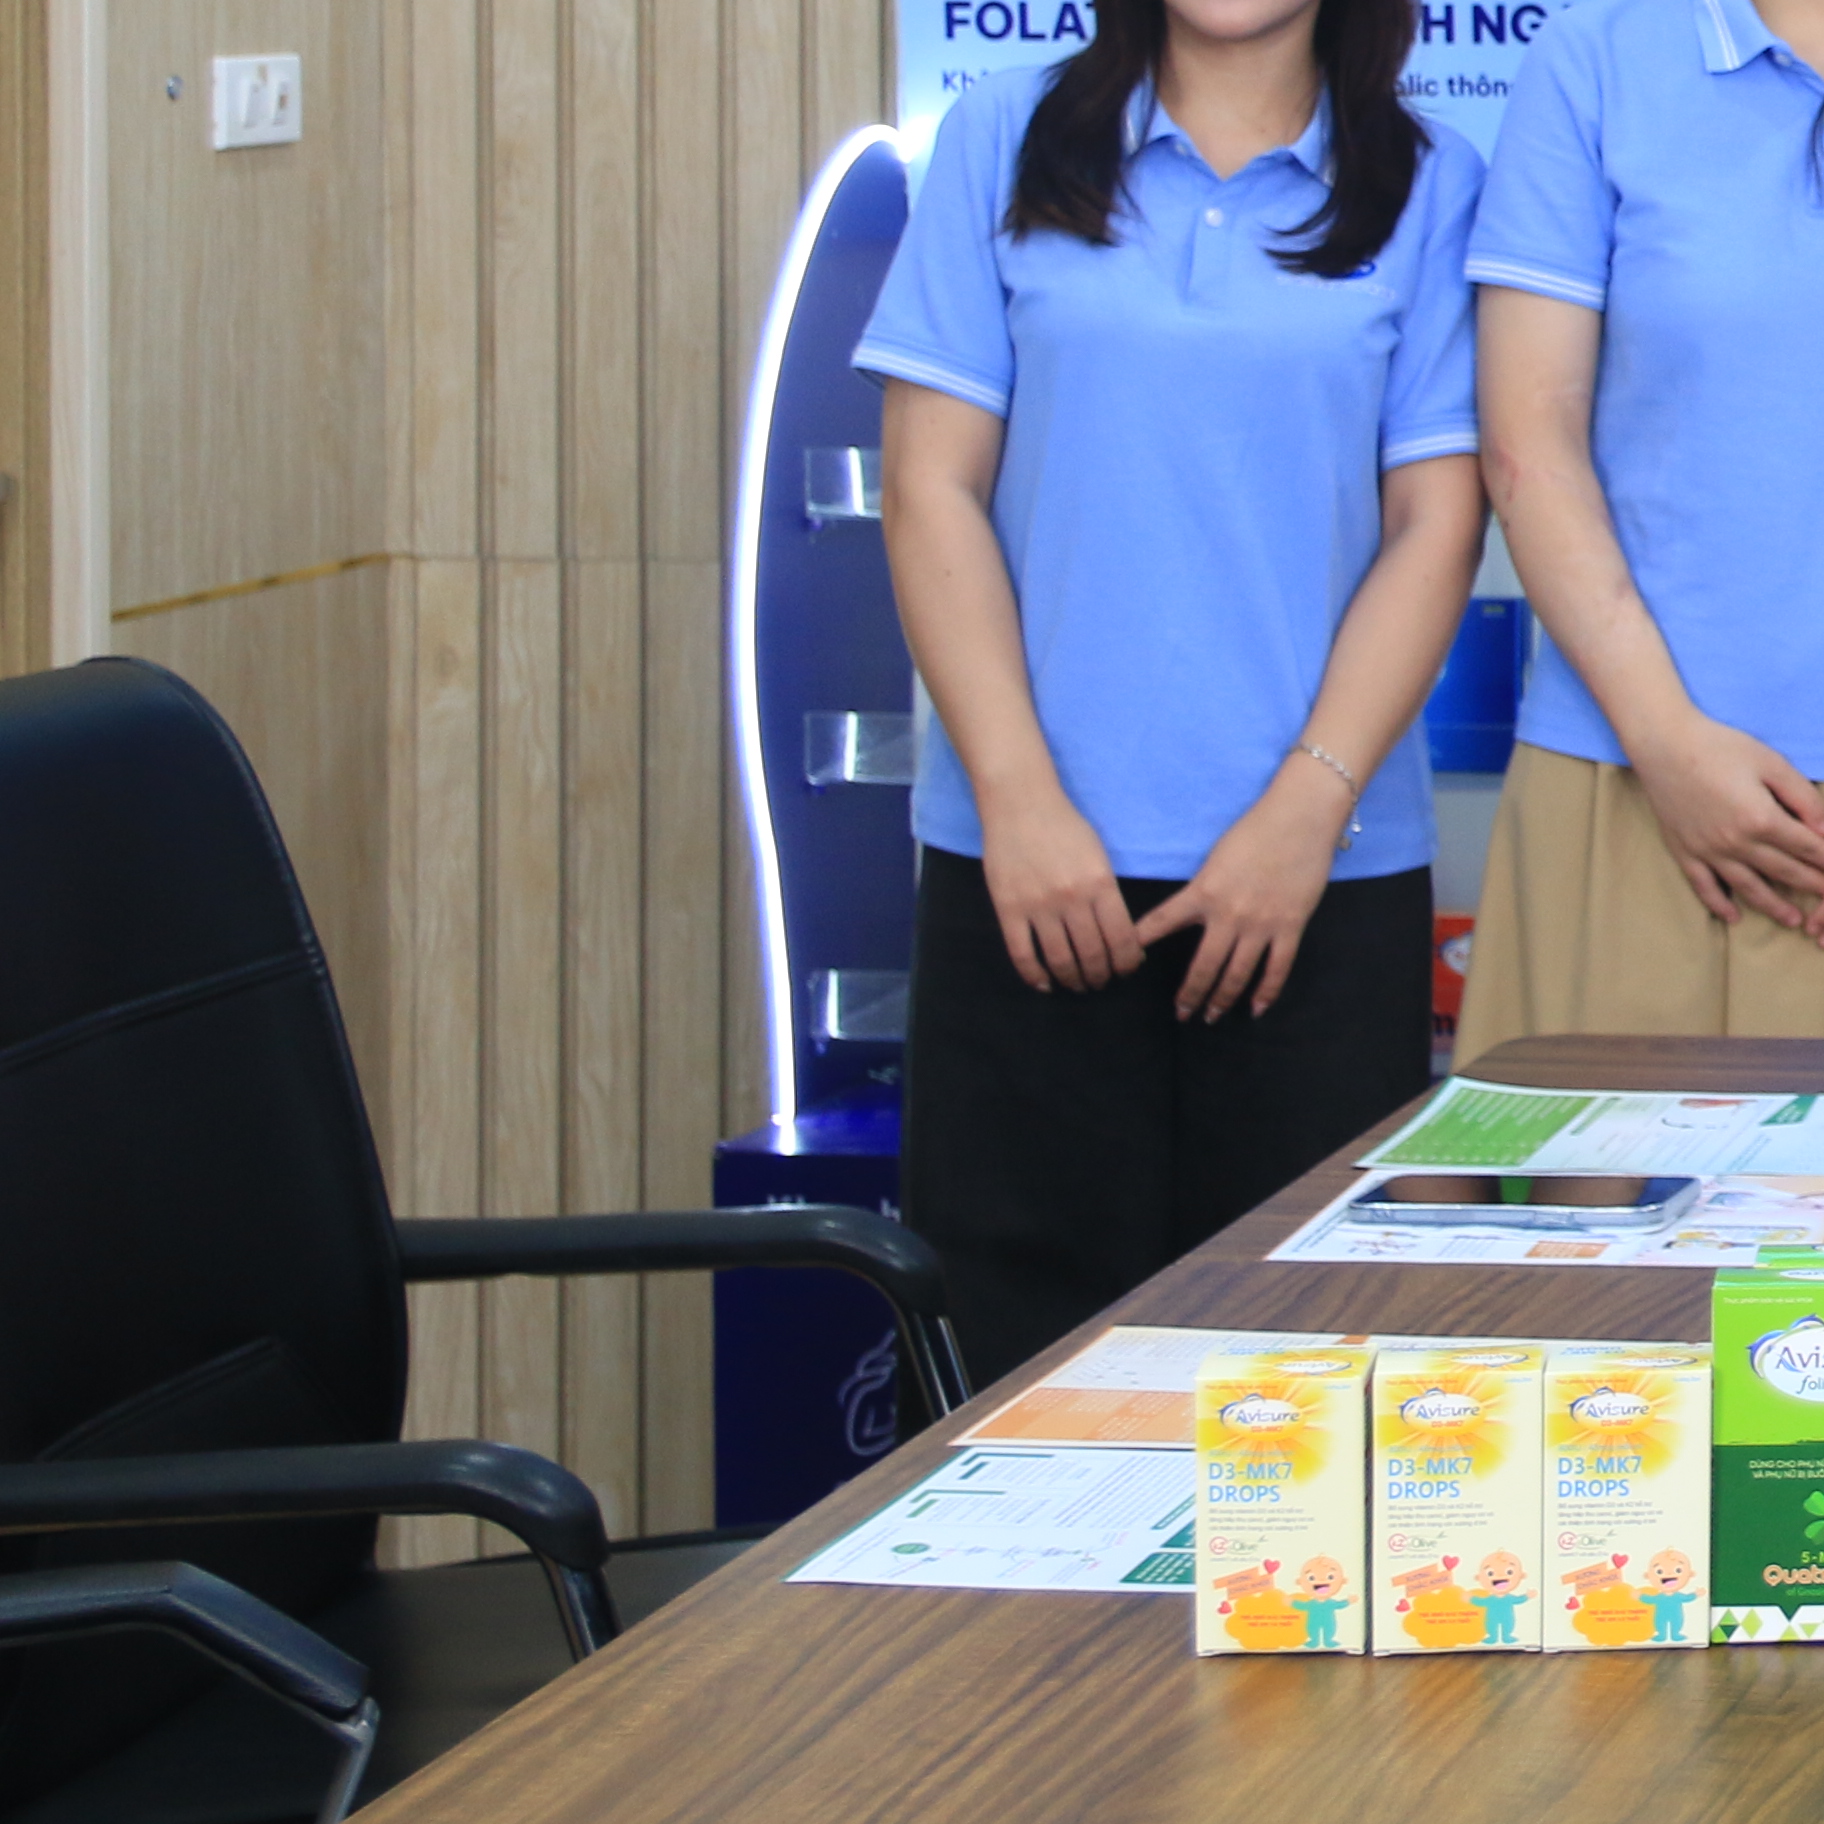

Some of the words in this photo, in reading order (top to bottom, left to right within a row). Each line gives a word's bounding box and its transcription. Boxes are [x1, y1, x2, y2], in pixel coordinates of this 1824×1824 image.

[1448, 75, 1513, 97] thôn
[1235, 1408, 1300, 1424] Avisure
[1416, 1404, 1480, 1419] Avisure
[1586, 1403, 1650, 1418] Avisure
[1208, 1462, 1293, 1480] D3-MK7
[1388, 1457, 1473, 1476] D3-MK7
[1558, 1456, 1642, 1475] D3-MK7
[1748, 1459, 1774, 1469] DÙNG
[1776, 1459, 1796, 1468] CHO
[1208, 1485, 1281, 1502] DROPS
[1388, 1481, 1460, 1499] DROPS
[1558, 1479, 1630, 1497] DROPS
